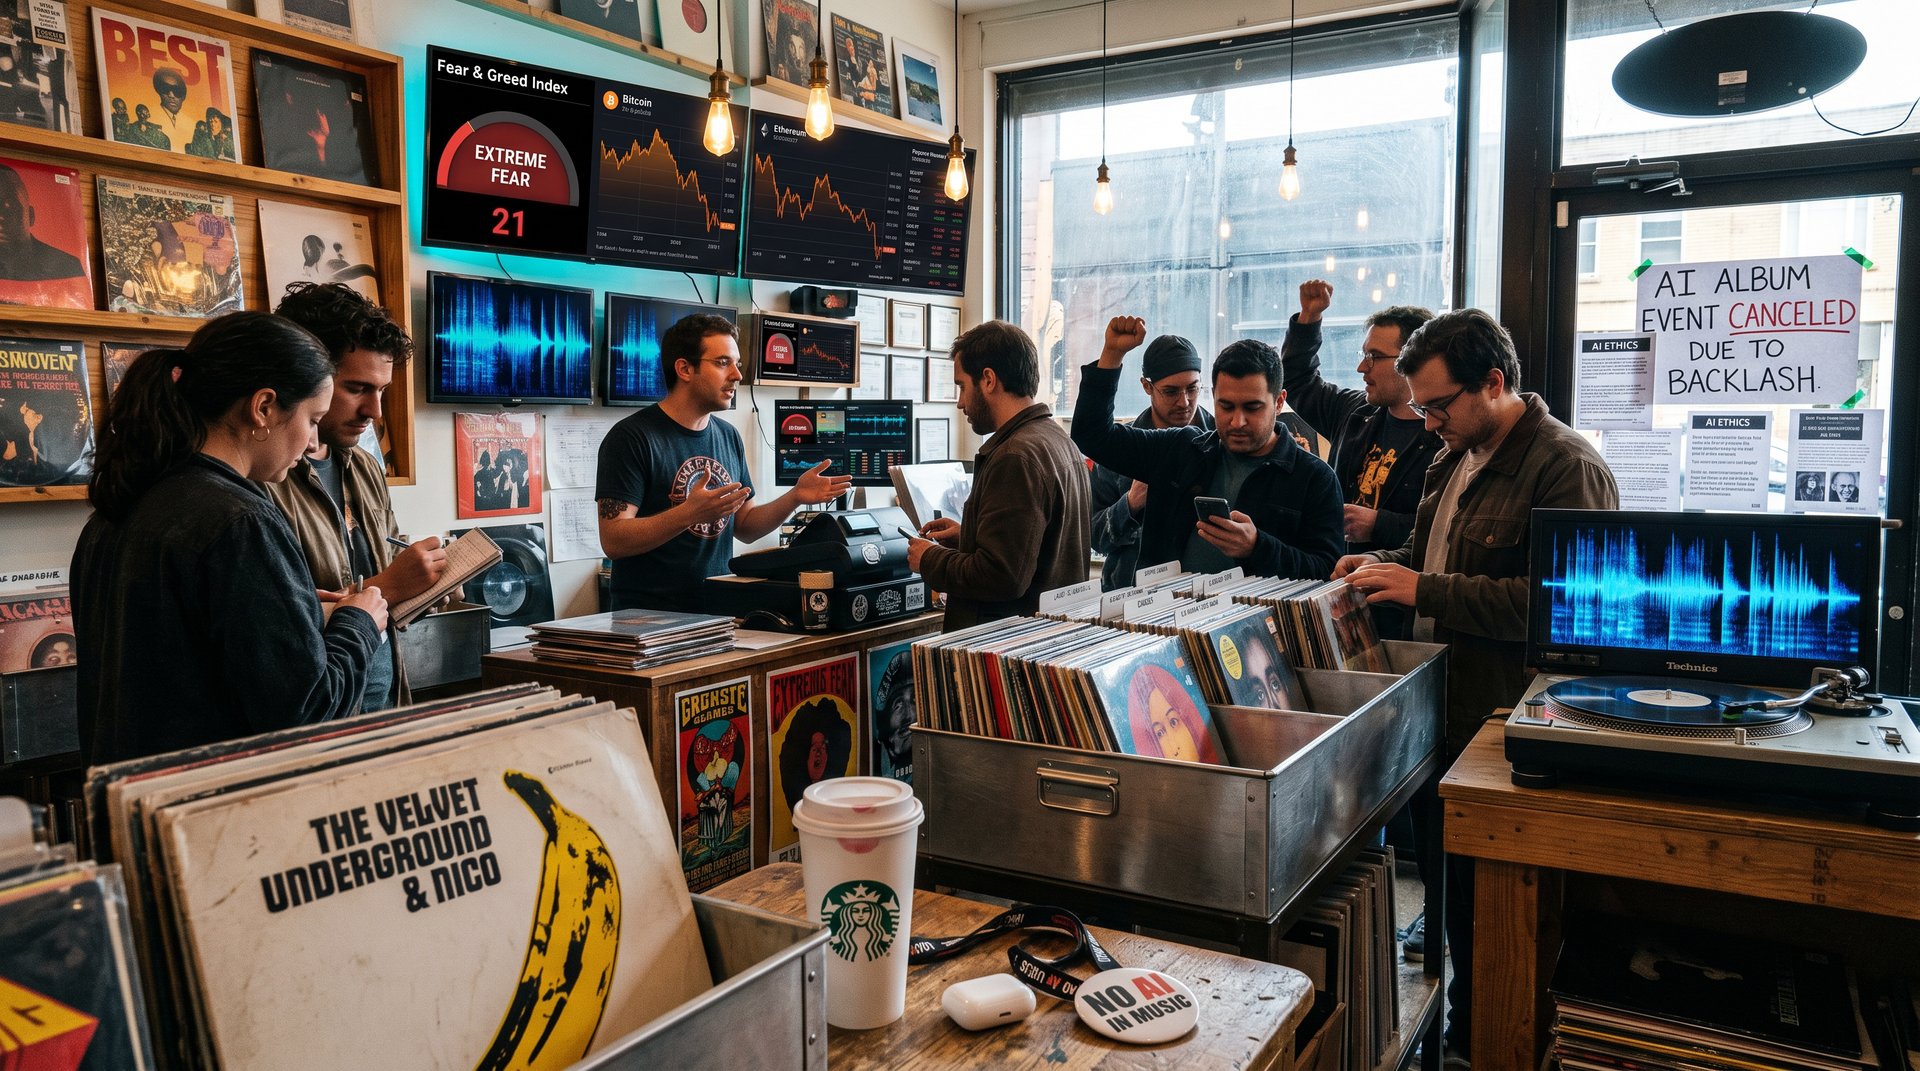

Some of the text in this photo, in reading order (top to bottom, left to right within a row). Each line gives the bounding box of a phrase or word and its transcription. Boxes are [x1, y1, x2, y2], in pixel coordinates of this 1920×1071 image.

[100, 17, 225, 110] BEST
[437, 58, 569, 95] Fear & Greed Index
[622, 94, 652, 107] Bitcoin
[773, 124, 806, 137] Ethereum
[475, 144, 547, 169] EXTREME
[491, 168, 530, 187] FEAR
[492, 207, 524, 237] 21
[1654, 264, 1811, 298] AI ALBUM
[1642, 299, 1856, 333] EVENT CANCELED
[1592, 341, 1639, 350] AI ETHICS
[1689, 339, 1784, 361] DUE TO
[1668, 365, 1821, 395] BACKLASH.
[1705, 418, 1750, 427] AI ETHICS
[1666, 661, 1718, 673] Technics
[309, 777, 481, 854] THE VELVET
[260, 814, 492, 914] UNDERGROUND
[402, 851, 502, 914] & NICO
[1081, 972, 1176, 1017] NO AI
[1106, 994, 1192, 1033] IN MUSIC
